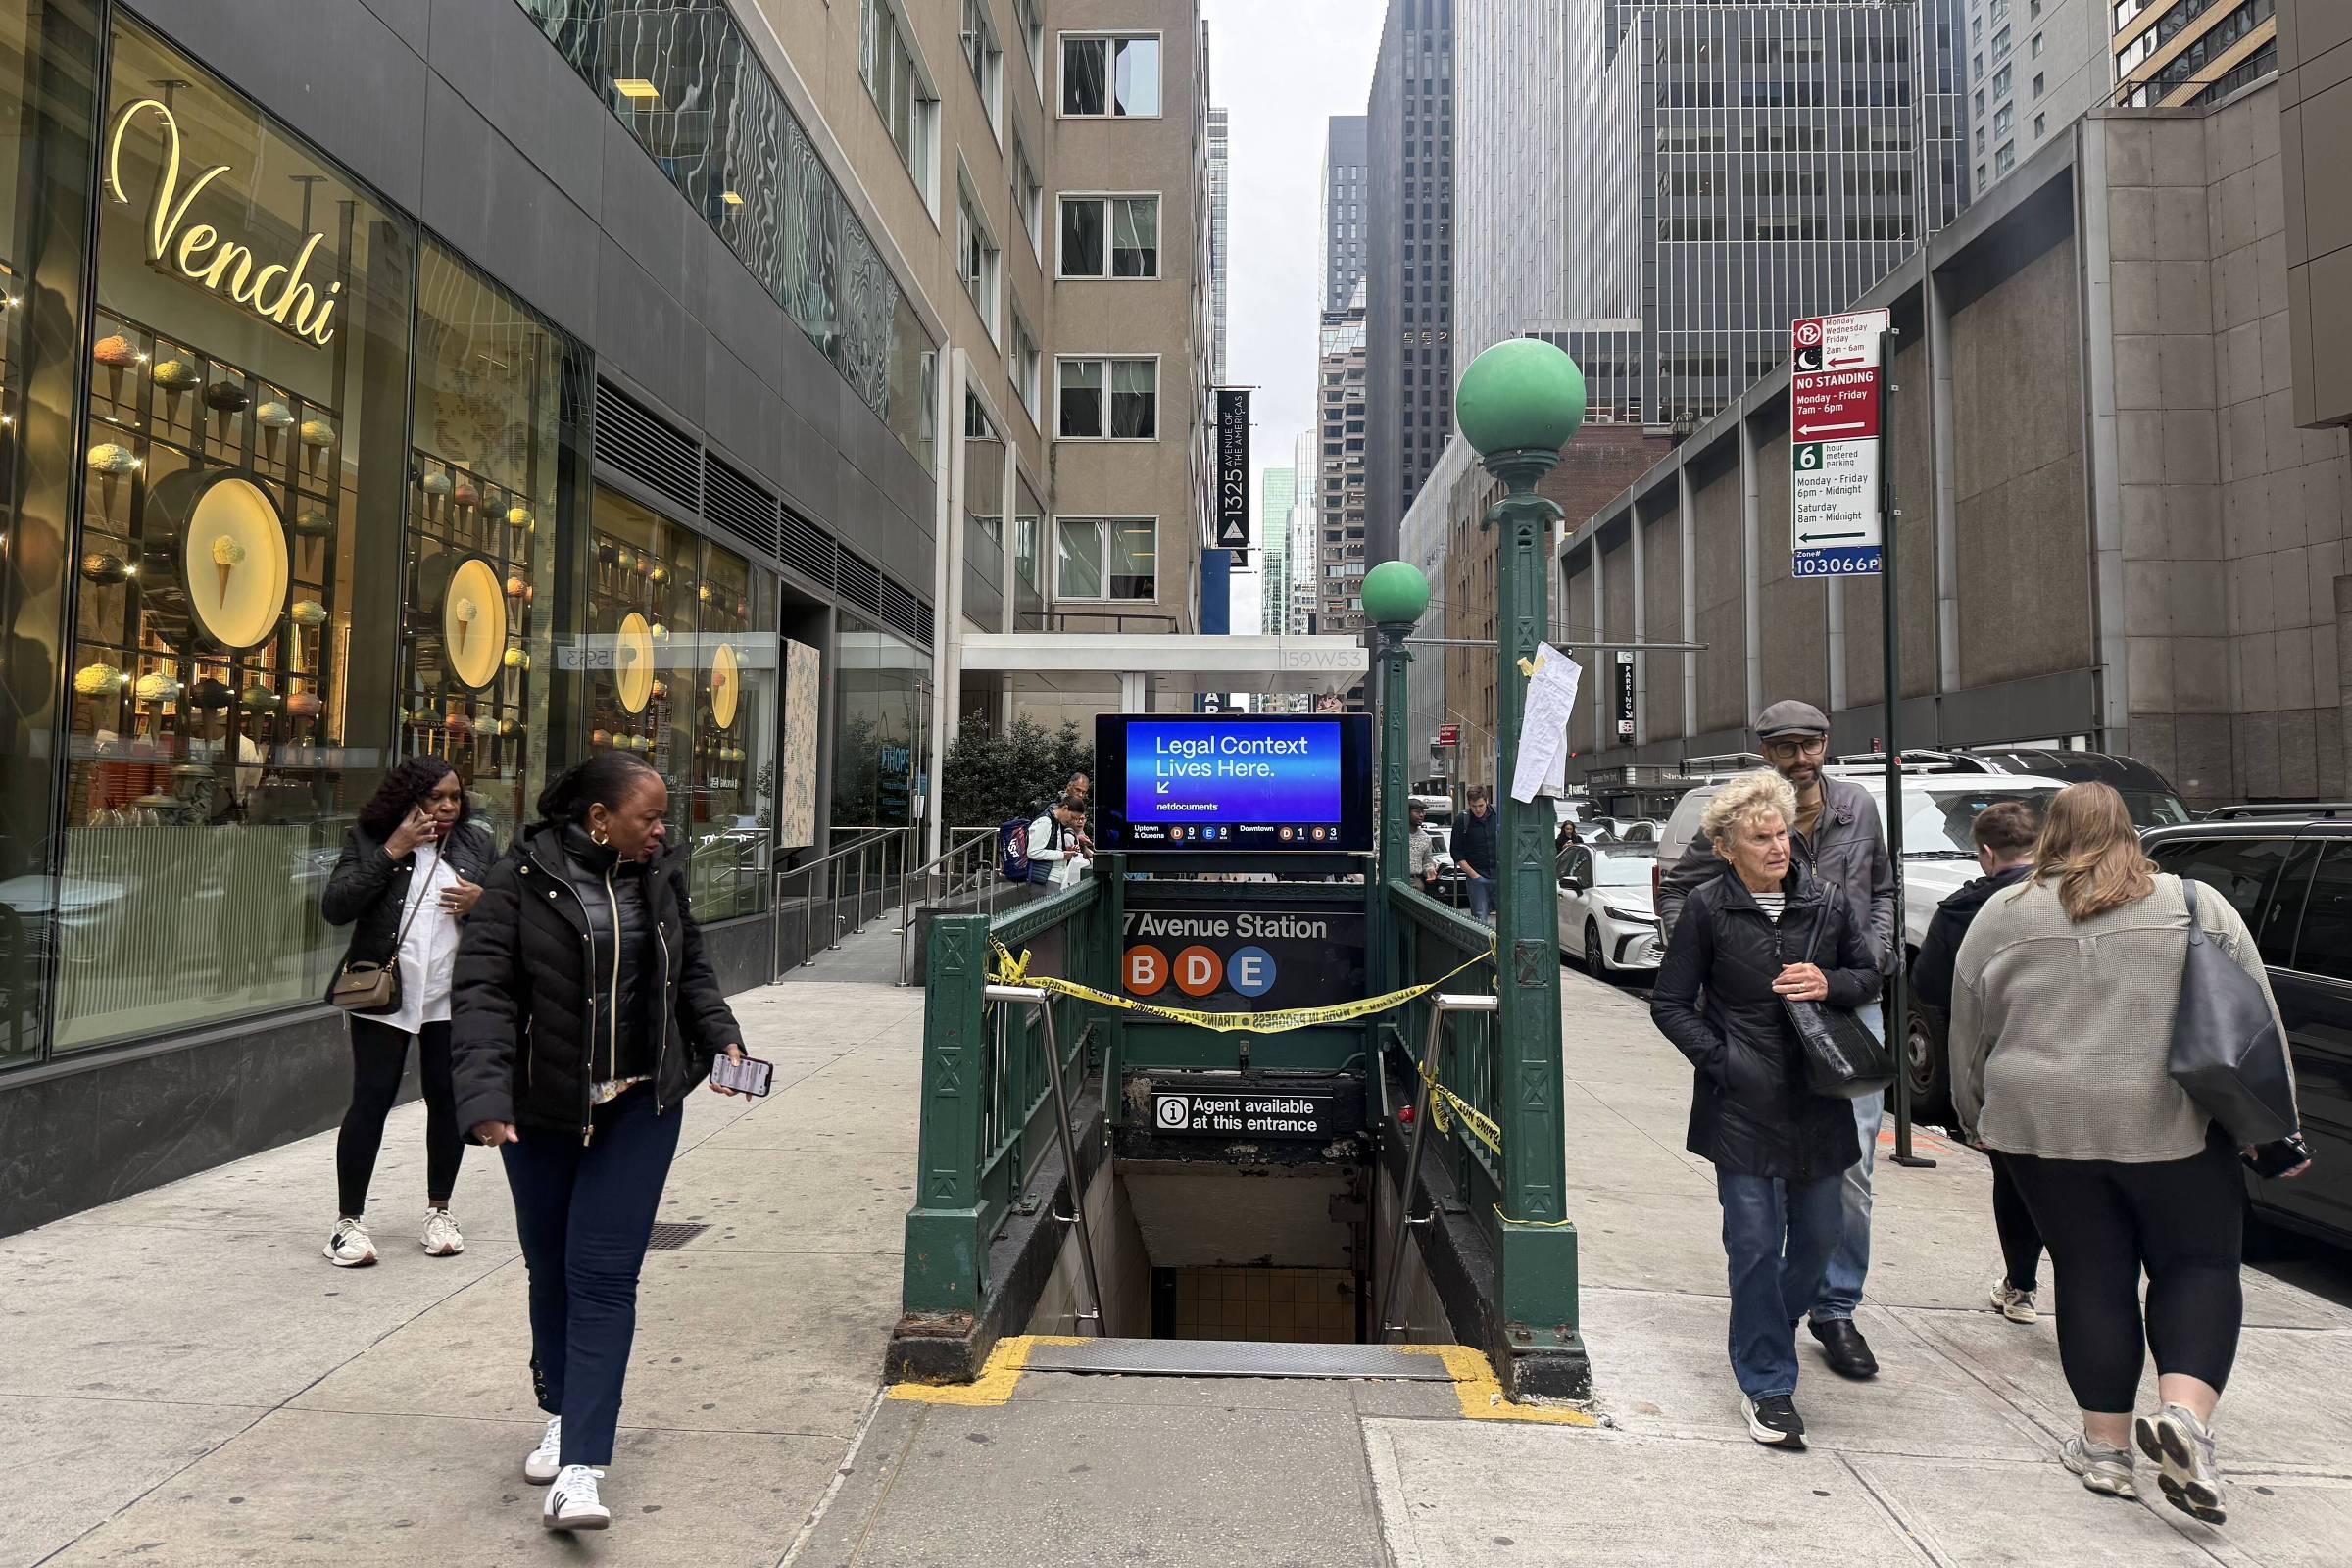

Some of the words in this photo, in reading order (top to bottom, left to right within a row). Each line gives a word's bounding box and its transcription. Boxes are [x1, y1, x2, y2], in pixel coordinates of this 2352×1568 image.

[111, 99, 341, 345] Venchi
[1826, 317, 1855, 326] Monday
[1826, 324, 1867, 334] Wednesday
[1826, 335, 1849, 344] Friday
[1796, 378, 1813, 389] NO
[1816, 371, 1874, 387] STANDING
[1796, 394, 1831, 405] Monday
[1839, 390, 1867, 400] Friday
[1797, 406, 1815, 415] 7am
[1824, 403, 1843, 414] 6pm
[1225, 412, 1233, 426] OF
[1234, 395, 1243, 446] AMERICAS
[1800, 446, 1816, 468] 6
[1826, 451, 1858, 460] metered
[1826, 459, 1854, 468] parking
[1797, 476, 1831, 487] Monday
[1839, 473, 1869, 484] Friday
[1225, 468, 1243, 517] 1325
[1797, 488, 1817, 499] 6pm
[1826, 485, 1862, 496] Midnight
[1797, 503, 1837, 513] Saturday
[1797, 514, 1817, 523] 8am
[1826, 511, 1862, 522] Midnight
[1796, 557, 1867, 574] 103066
[1283, 651, 1312, 667] 159
[1156, 736, 1215, 759] Legal
[1220, 736, 1308, 755] Context
[1156, 760, 1212, 777] Lives
[1217, 760, 1275, 777] Here.
[1156, 803, 1218, 811] netdocuments
[1188, 827, 1195, 836] 9
[1220, 827, 1227, 836] 9
[1298, 828, 1303, 837] 1
[1123, 913, 1135, 934] 7
[1138, 912, 1229, 937] Avenue
[1236, 913, 1327, 939] Station
[1132, 956, 1155, 985] B
[1187, 956, 1212, 985] D
[1241, 956, 1262, 986] E
[1192, 1097, 1240, 1114] Agent
[1245, 1099, 1314, 1114] available
[1192, 1116, 1209, 1129] at
[1213, 1115, 1242, 1130] this
[1247, 1118, 1317, 1133] entrance
